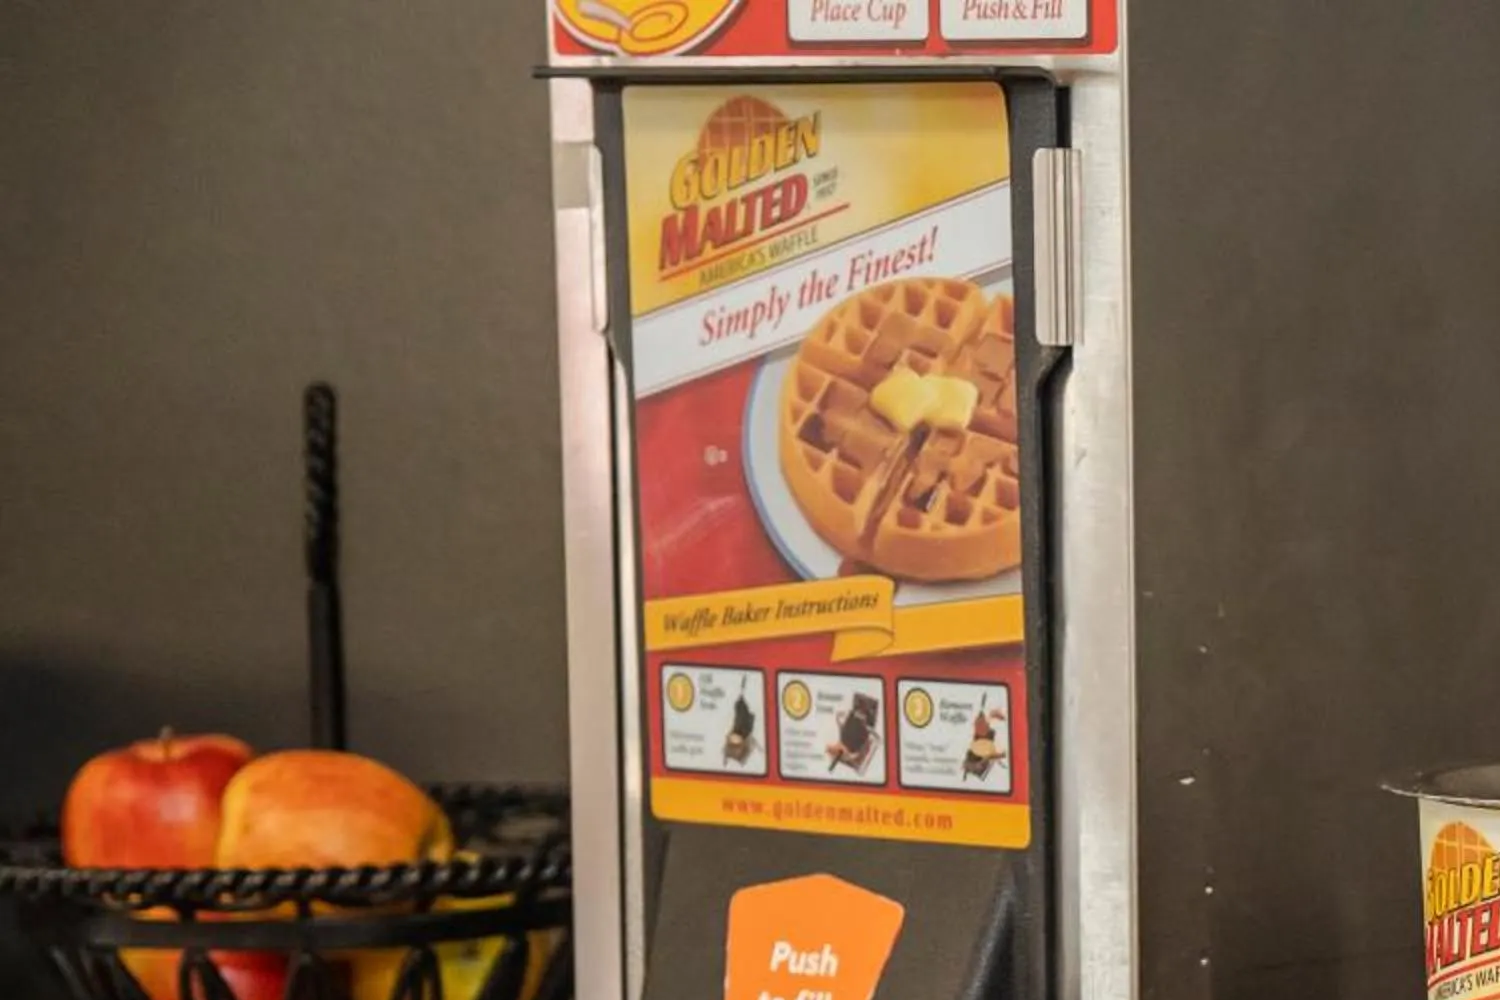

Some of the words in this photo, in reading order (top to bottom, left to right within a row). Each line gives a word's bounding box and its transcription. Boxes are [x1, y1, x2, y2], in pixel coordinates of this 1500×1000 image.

[810, 0, 861, 22] Place
[866, 0, 907, 28] Cup
[962, 0, 1010, 20] Push
[669, 110, 822, 210] GOLDEN
[659, 173, 808, 271] MALTED
[699, 285, 791, 346] Simply
[797, 268, 840, 309] the
[846, 225, 940, 291] Finest!
[663, 606, 718, 637] Waffle
[721, 603, 770, 626] Baker
[775, 589, 880, 620] Instructions
[721, 798, 954, 830] www.goldenmalted.com
[769, 940, 839, 977] Push
